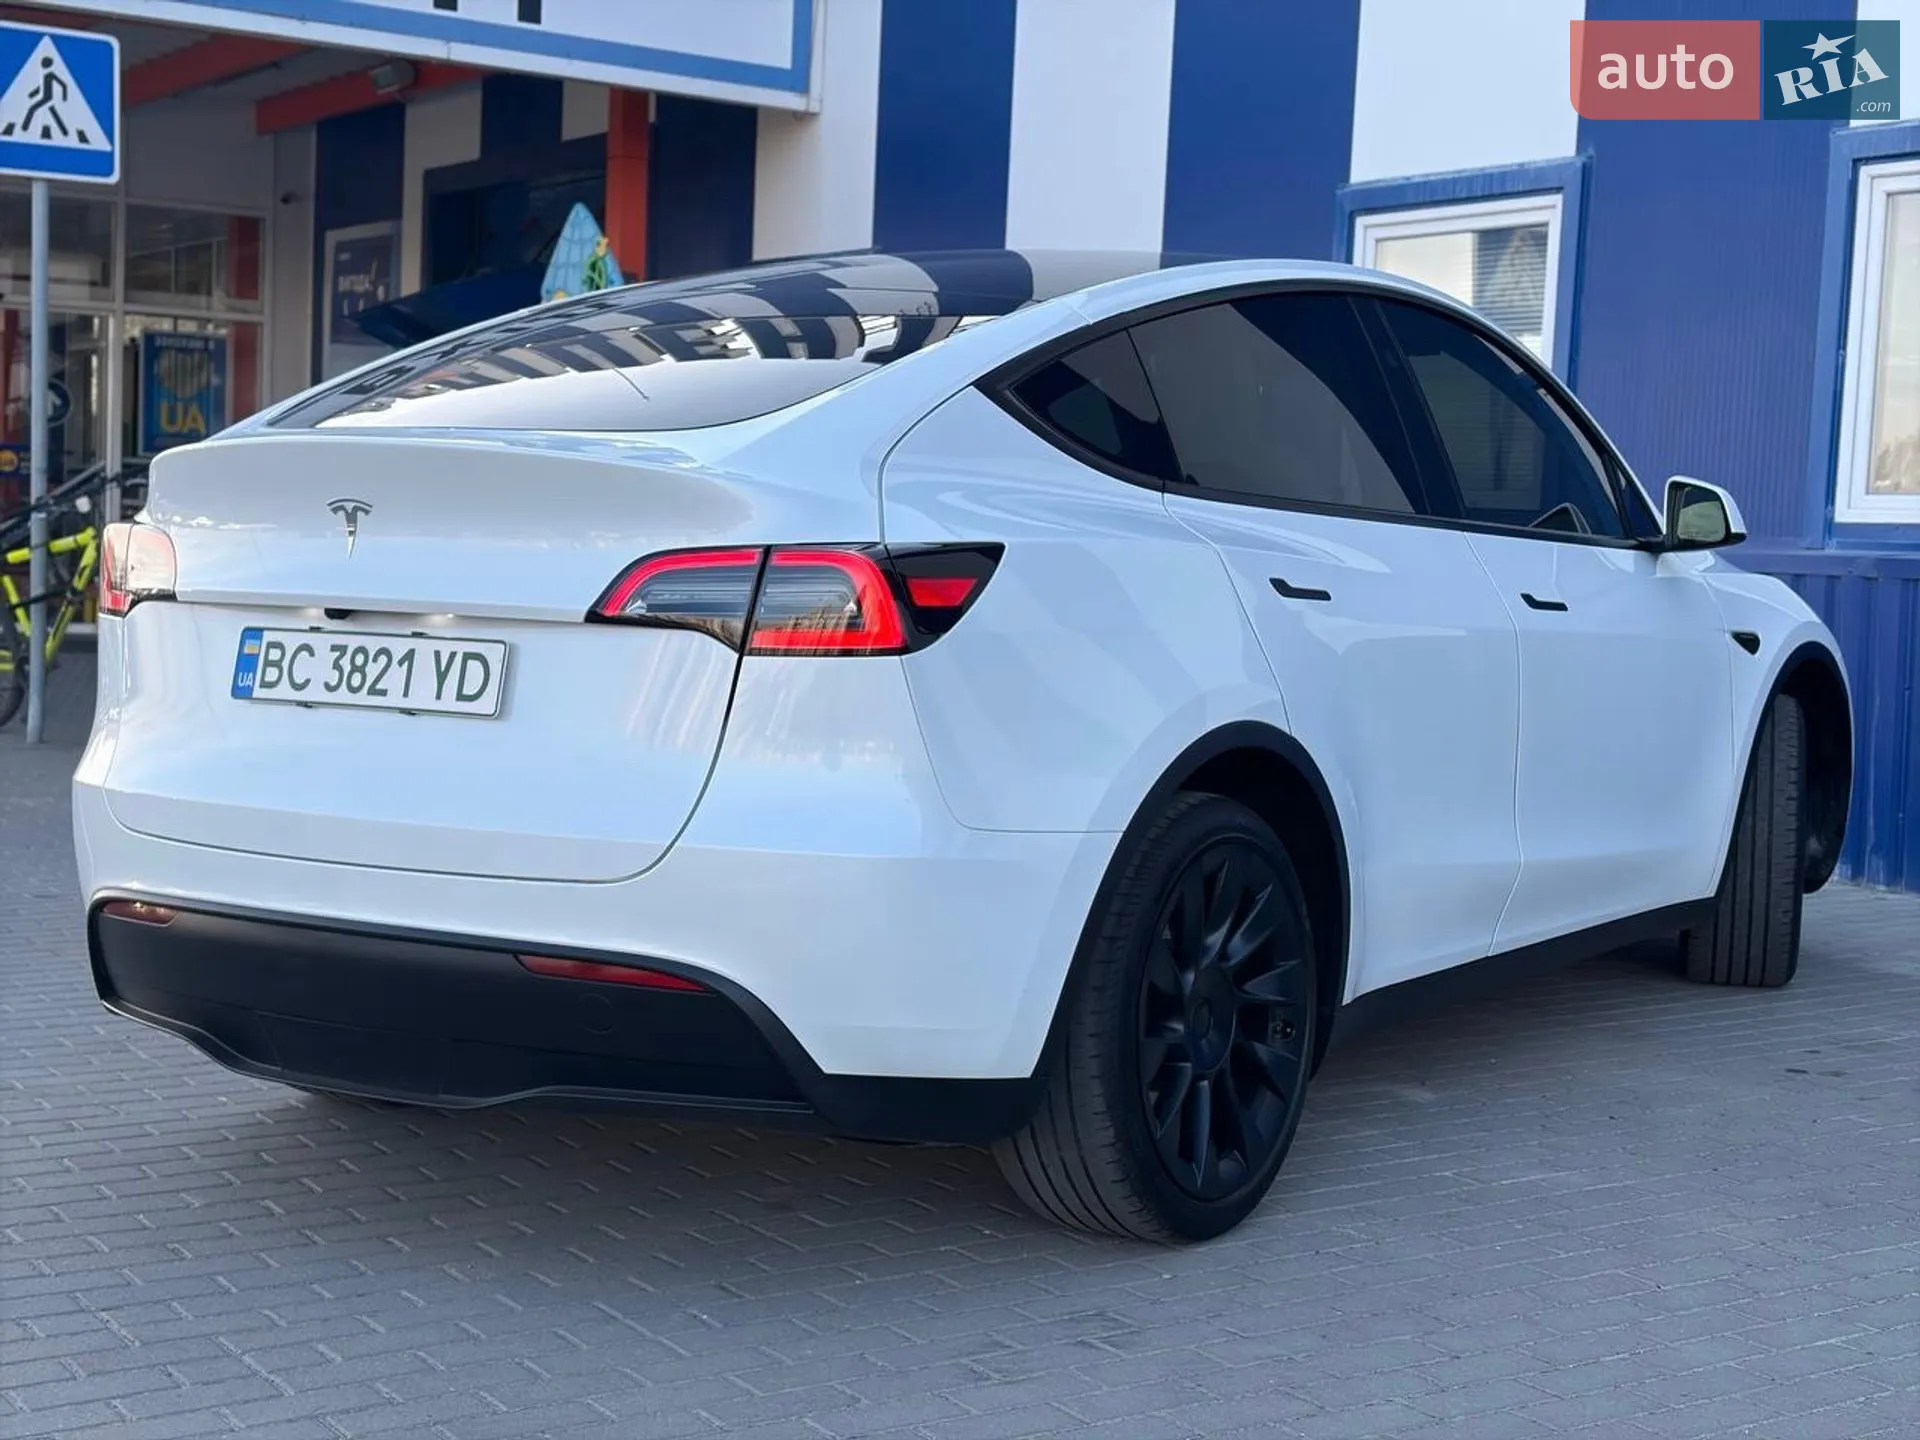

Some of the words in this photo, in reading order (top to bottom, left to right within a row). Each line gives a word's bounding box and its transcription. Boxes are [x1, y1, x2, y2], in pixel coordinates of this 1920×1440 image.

[160, 400, 206, 433] UA
[238, 671, 254, 687] UA
[258, 641, 315, 692] BC
[324, 644, 416, 698] 3821
[433, 649, 491, 702] YD
